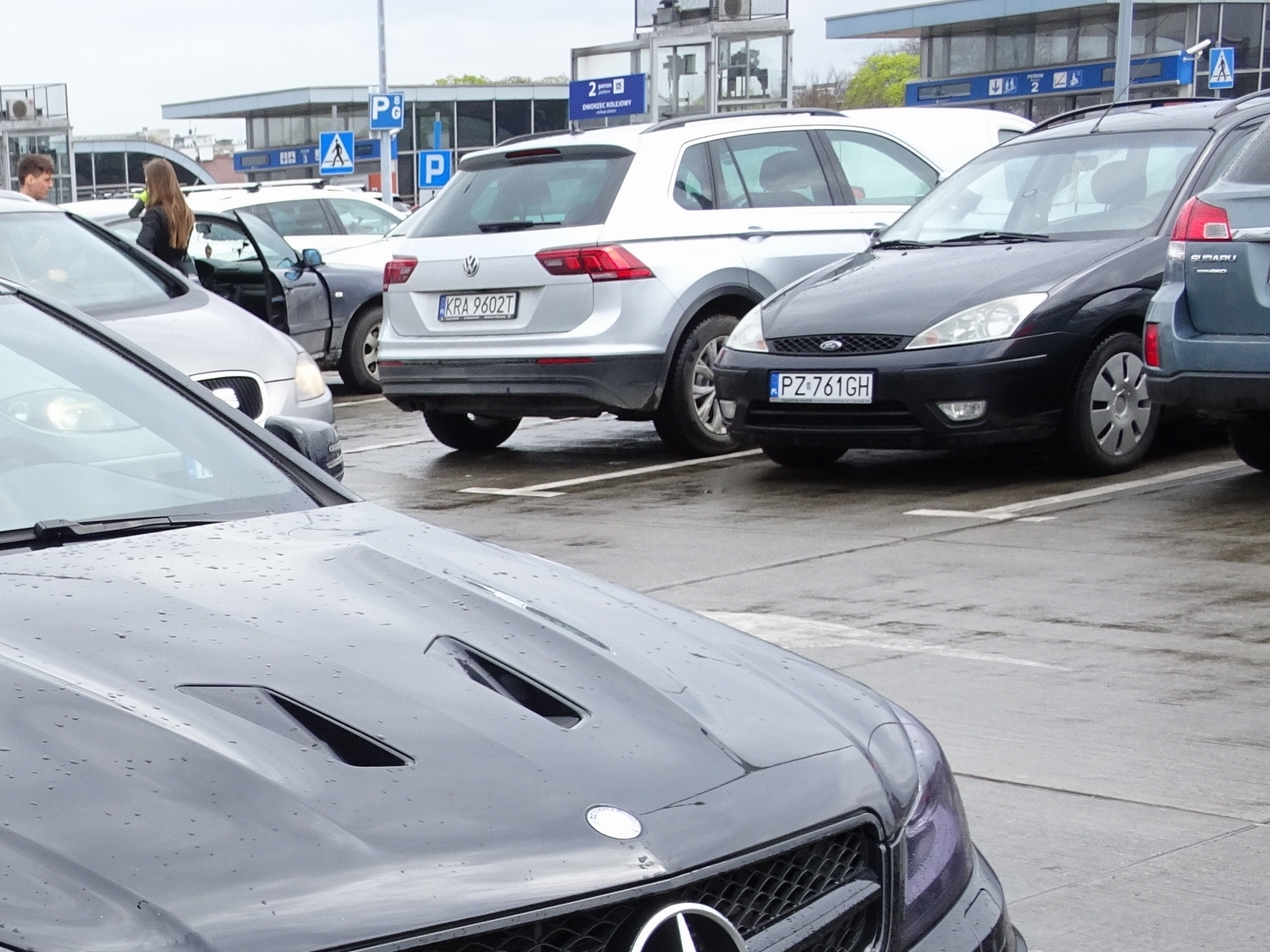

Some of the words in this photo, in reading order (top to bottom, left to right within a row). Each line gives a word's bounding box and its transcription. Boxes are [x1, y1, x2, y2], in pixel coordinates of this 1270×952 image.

[588, 81, 597, 97] 2
[1031, 82, 1039, 93] 2
[373, 96, 390, 120] P
[391, 106, 401, 120] G
[426, 154, 444, 184] P
[446, 297, 469, 315] KRA
[473, 295, 514, 314] 9602T
[782, 376, 806, 396] PZ
[813, 376, 870, 396] 761GH
